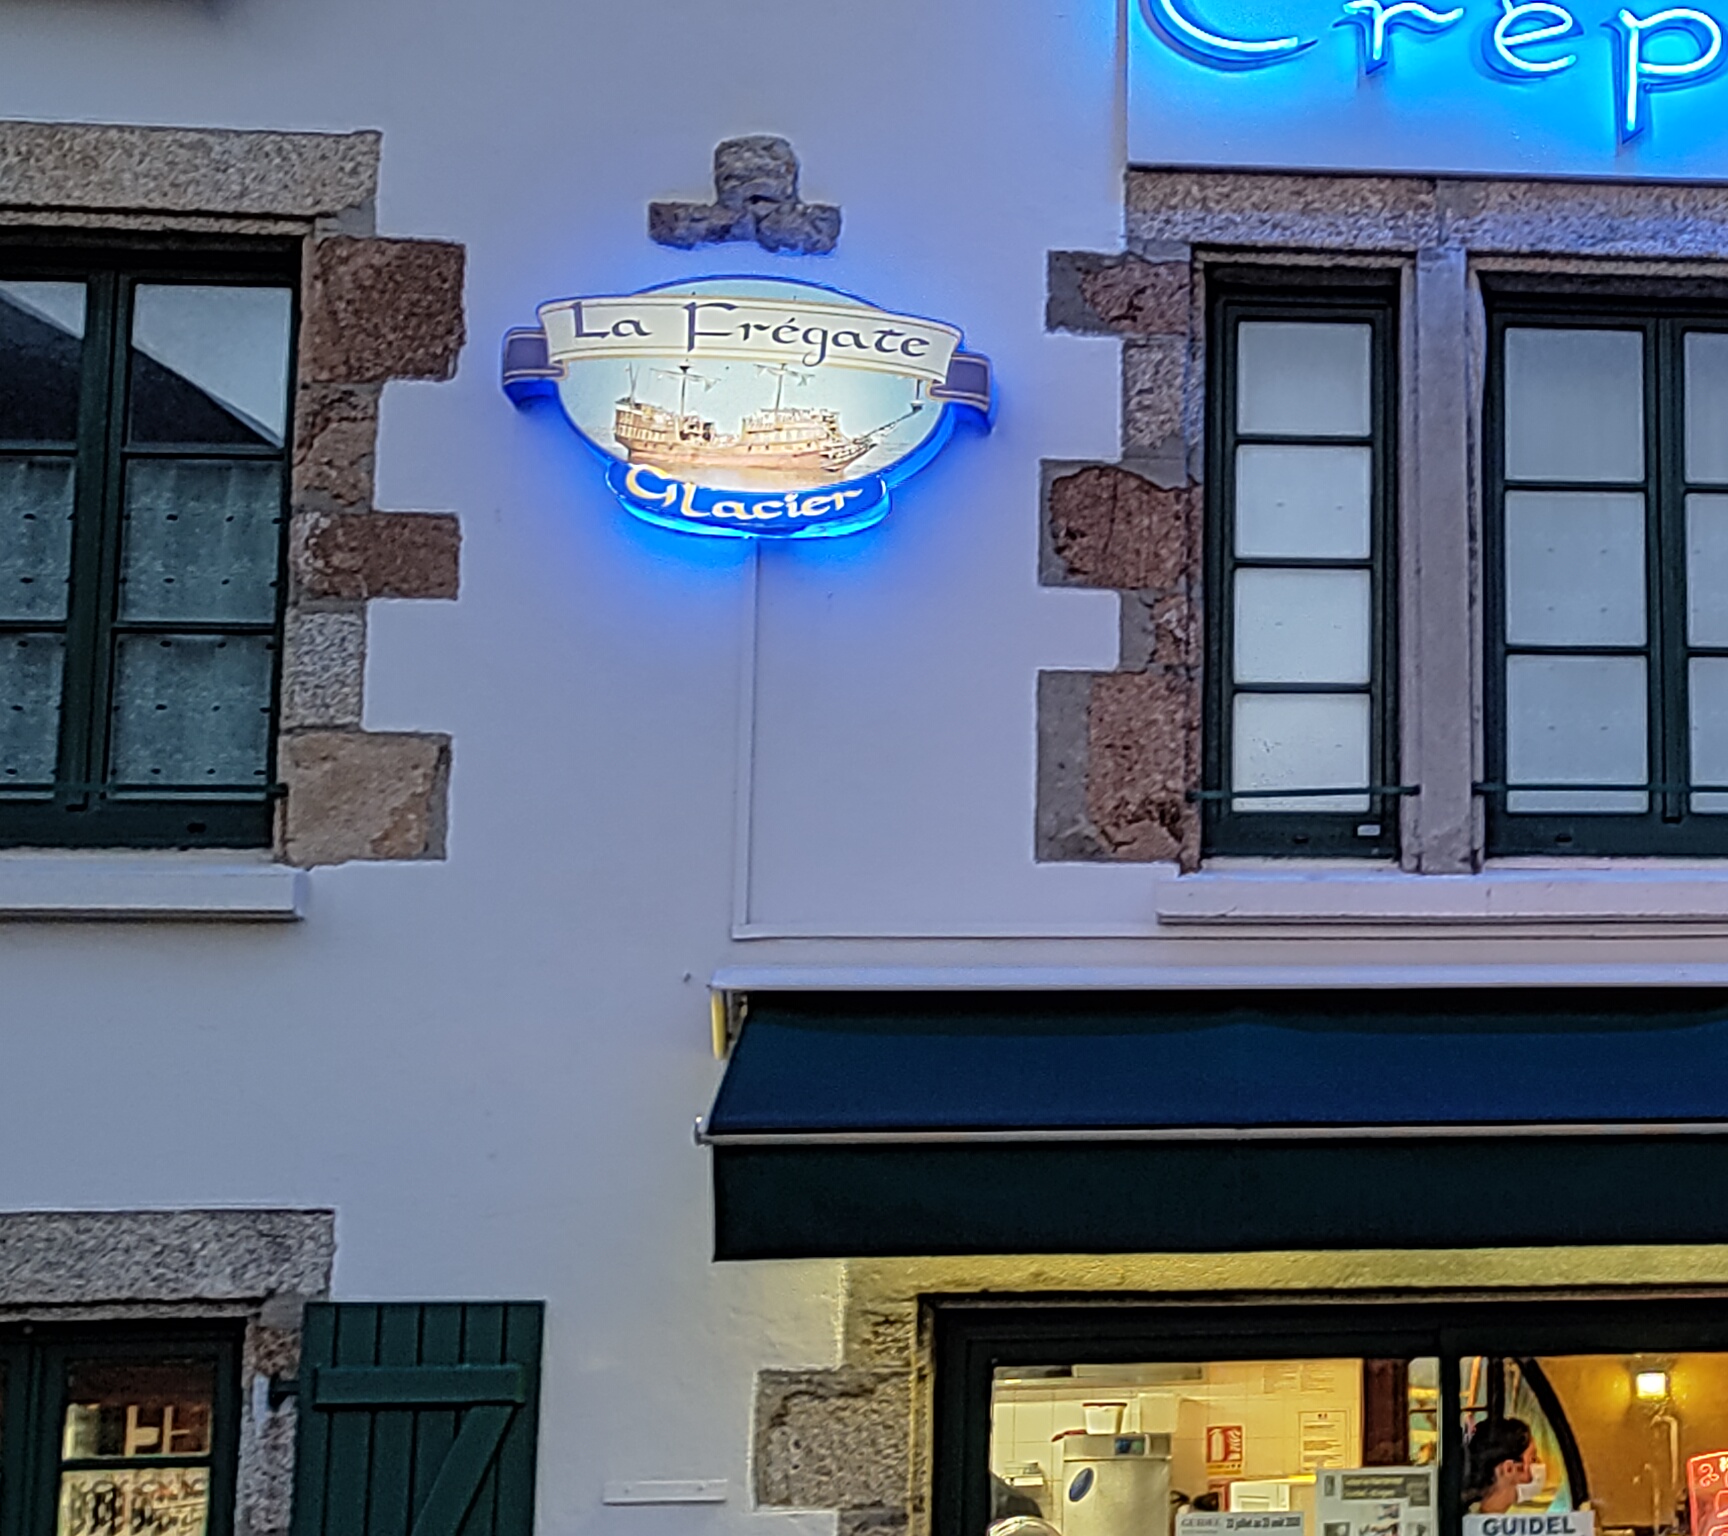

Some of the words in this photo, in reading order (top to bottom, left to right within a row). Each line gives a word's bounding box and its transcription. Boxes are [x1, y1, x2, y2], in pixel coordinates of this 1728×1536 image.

[571, 302, 653, 339] La
[683, 302, 931, 367] Frégate
[1482, 1516, 1576, 1536] GUIDEL
